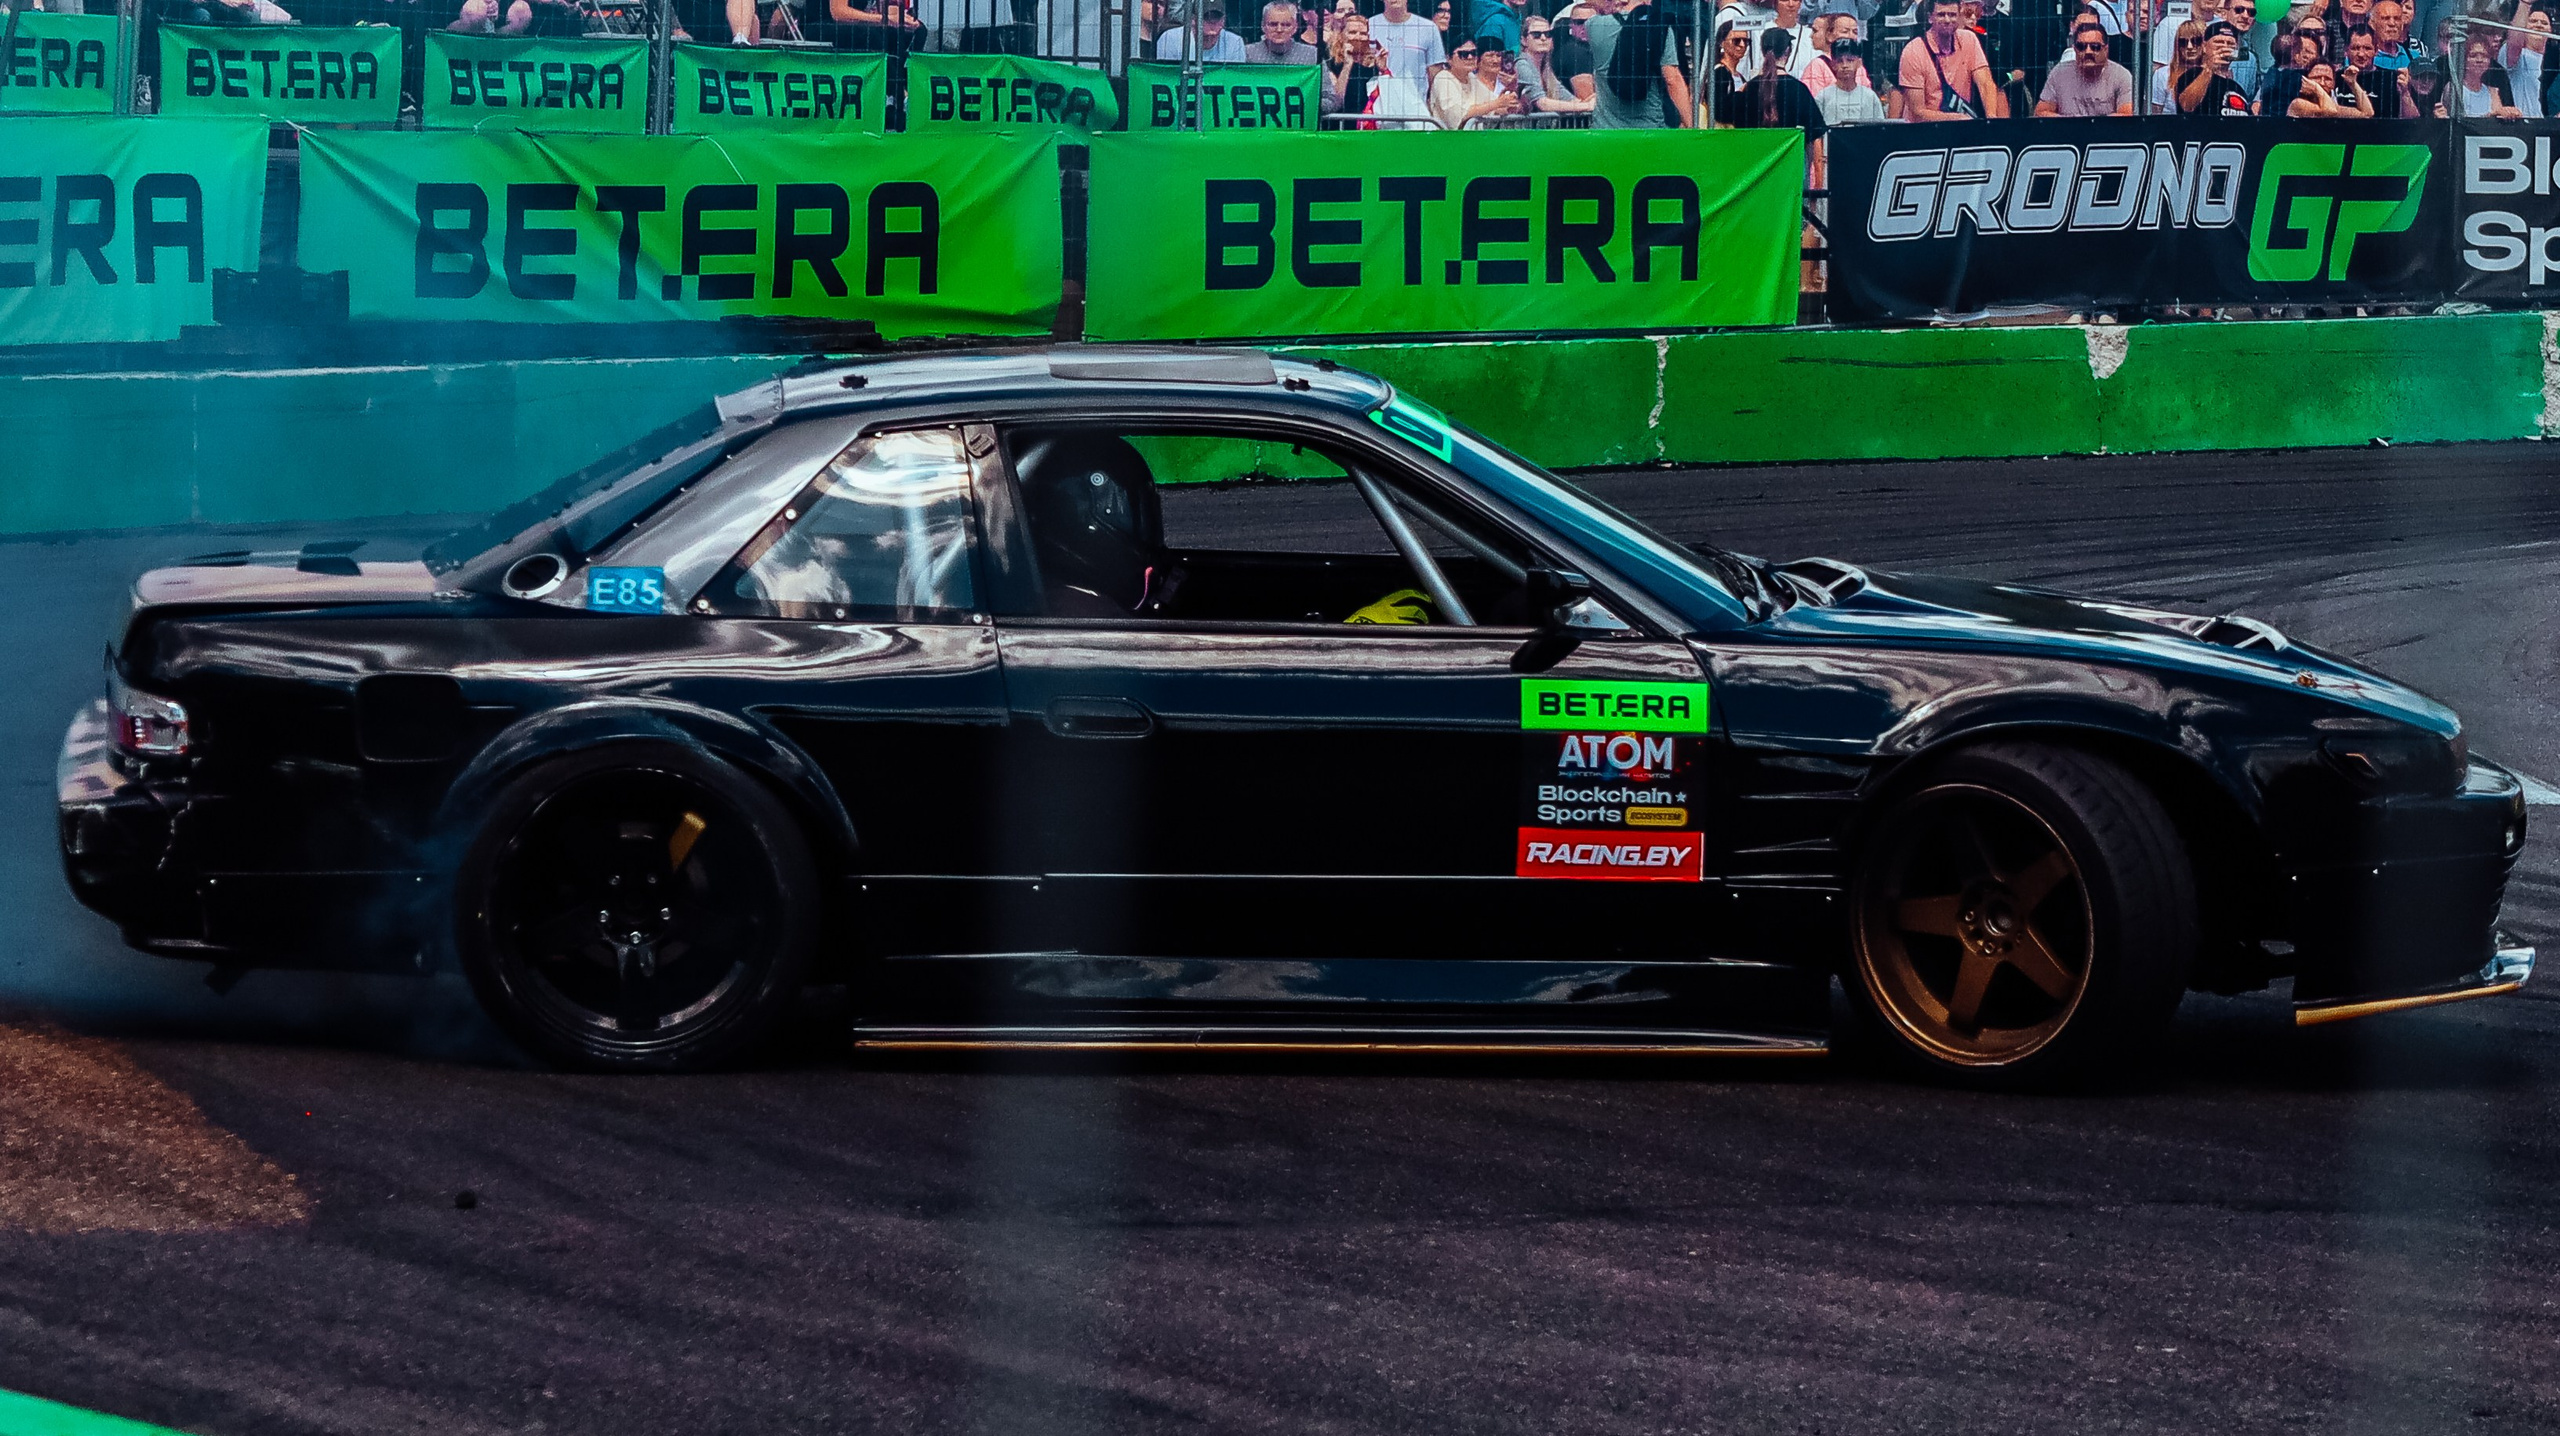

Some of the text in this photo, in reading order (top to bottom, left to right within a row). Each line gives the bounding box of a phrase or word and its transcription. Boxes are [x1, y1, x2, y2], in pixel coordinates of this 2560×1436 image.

[186, 48, 378, 99] BET.ERA
[448, 59, 624, 110] BET.ERA
[698, 68, 863, 119] BET.ERA
[930, 76, 1095, 124] BET.ERA
[2464, 136, 2560, 195] Bl
[1205, 175, 1700, 290] BET.ERA
[1867, 142, 2431, 281] GRODNO GP
[414, 181, 939, 300] BET.ERA
[592, 578, 661, 605] E85
[1538, 691, 1690, 719] BET.ERA
[1558, 735, 1673, 771] ATOM
[1537, 785, 1672, 804] Blockchain
[1537, 804, 1622, 824] Sports
[1526, 842, 1692, 867] RACING.BY
